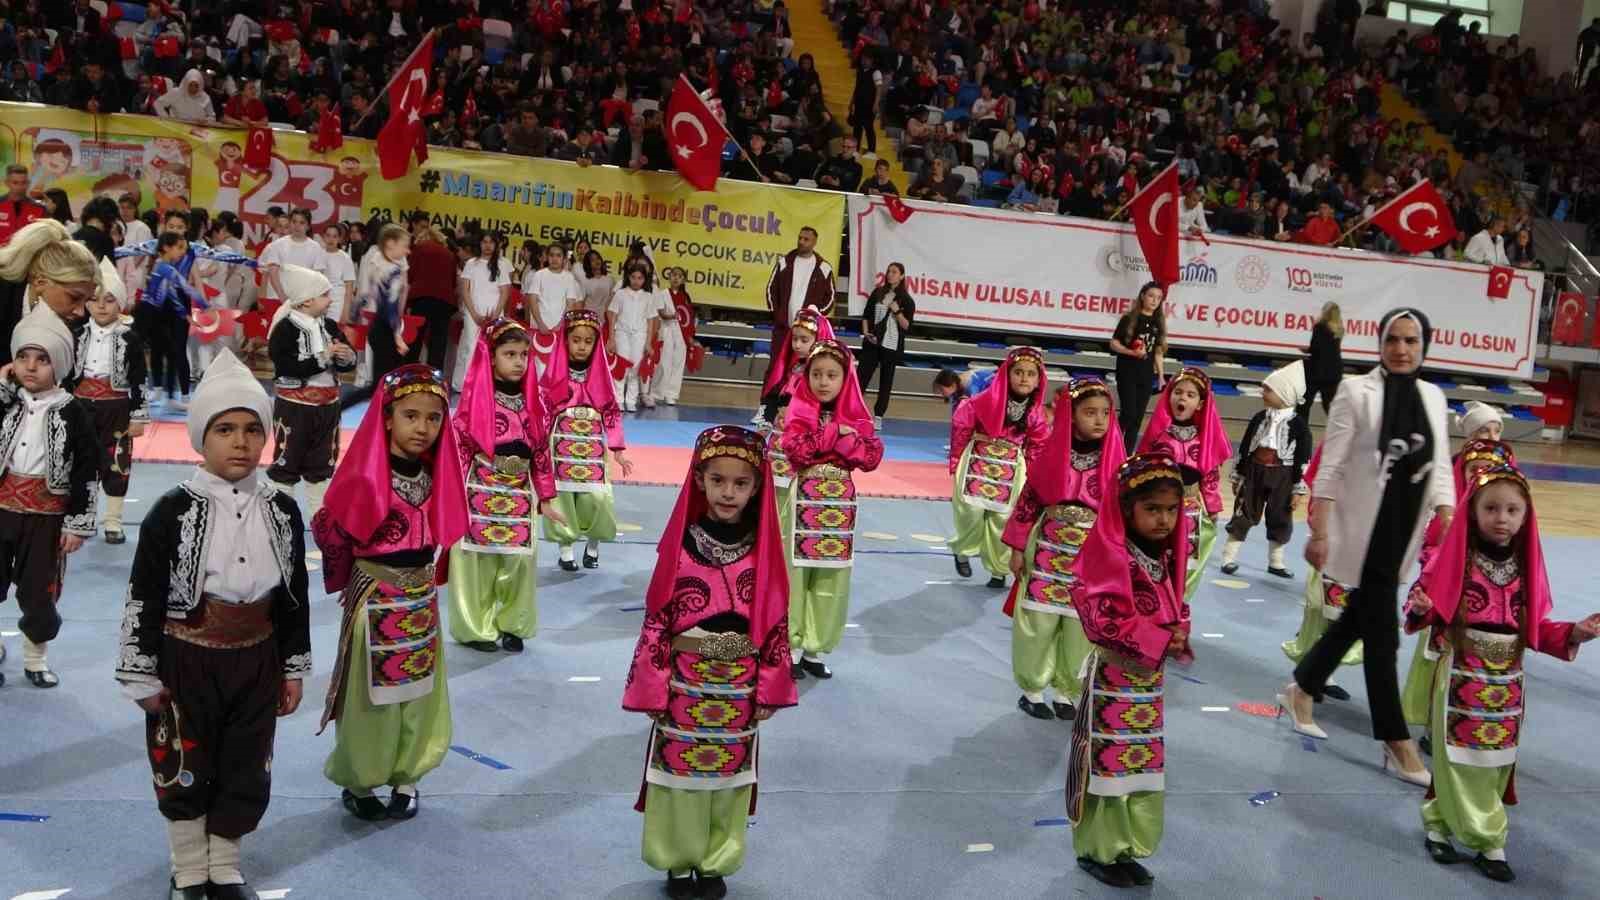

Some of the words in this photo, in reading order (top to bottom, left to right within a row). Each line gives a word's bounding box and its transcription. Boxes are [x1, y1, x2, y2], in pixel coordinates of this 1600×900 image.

[244, 157, 335, 225] 23
[420, 169, 782, 236] #MaarifinKalbindeÇocuk
[649, 236, 671, 253] VE
[676, 240, 737, 262] ÇOCUK
[661, 266, 745, 290] GLDİNİZ.
[907, 273, 970, 300] NİSAN
[975, 284, 1056, 309] ULUSAL
[1061, 293, 1178, 320] EGEMEK
[1186, 304, 1209, 321] VE
[1214, 306, 1279, 328] ÇOCUK
[1460, 332, 1517, 354] OLSUN
